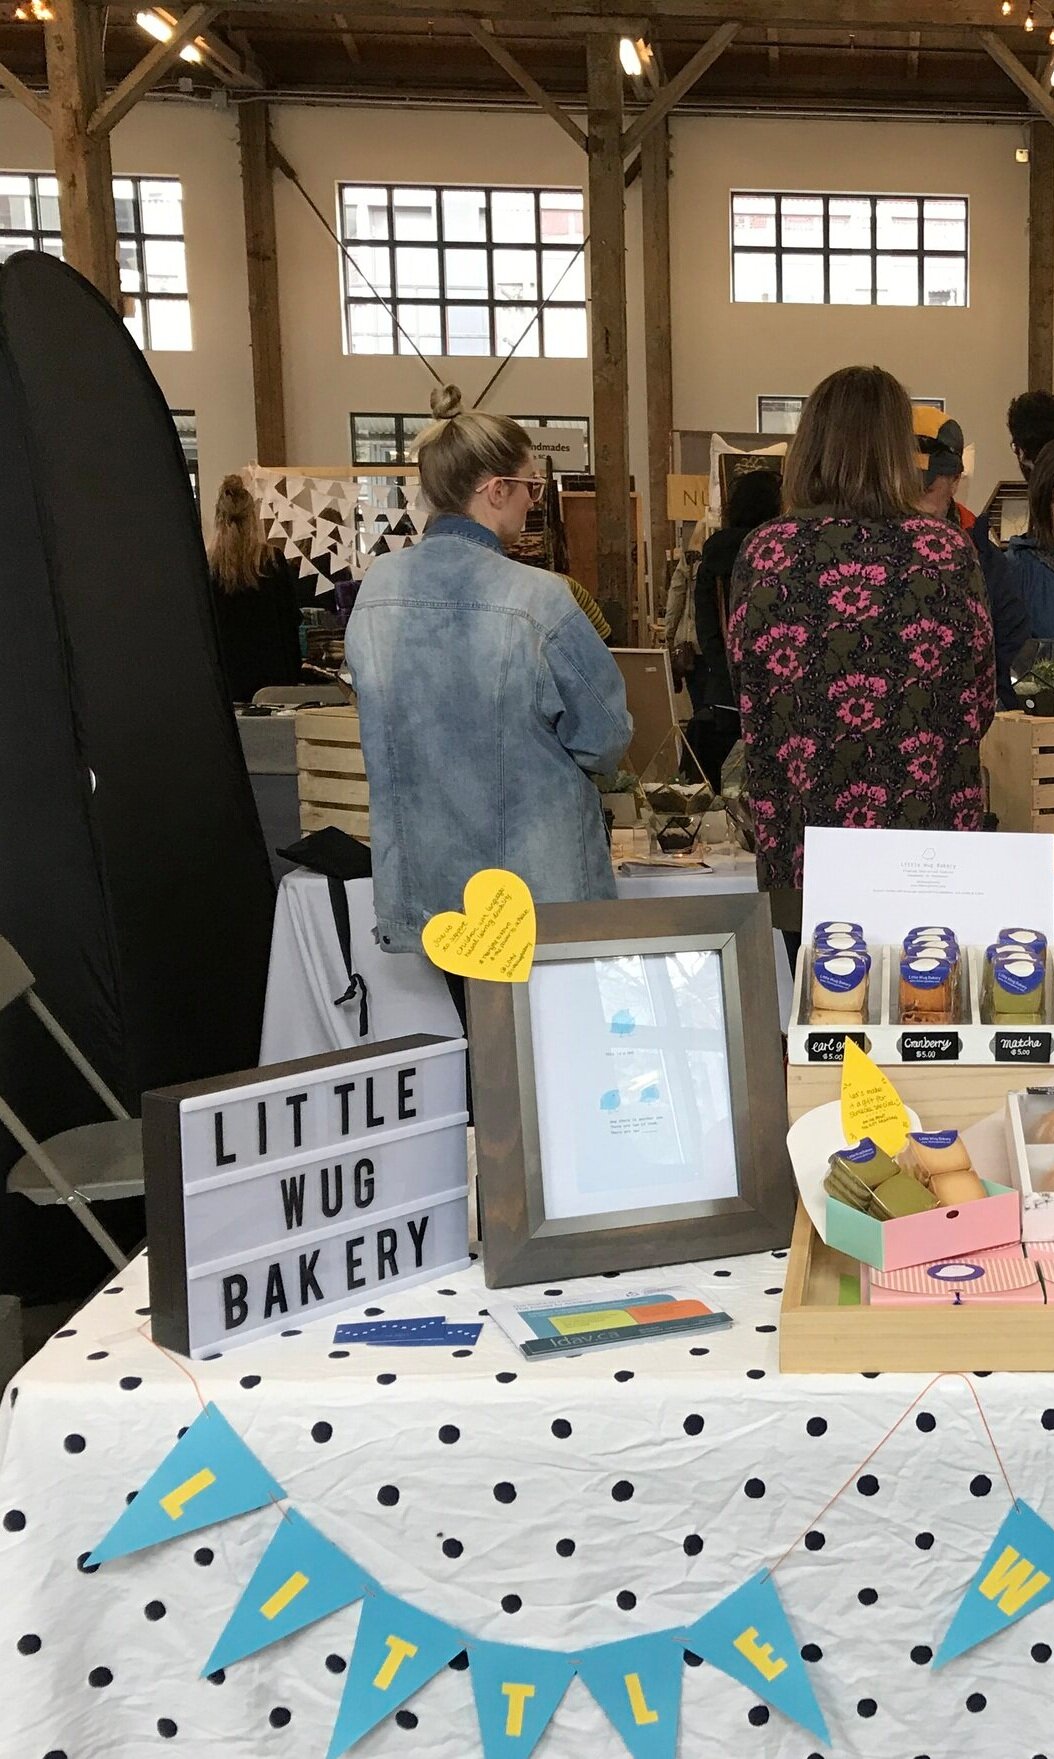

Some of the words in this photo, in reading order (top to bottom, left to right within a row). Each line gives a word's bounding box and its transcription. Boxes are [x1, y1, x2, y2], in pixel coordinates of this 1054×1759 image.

[531, 442, 570, 452] ndmades
[811, 1038, 835, 1053] earl
[904, 1038, 952, 1051] Cranberry
[916, 1051, 936, 1059] $5.00
[214, 1067, 416, 1167] LITTLE
[280, 1158, 375, 1230] WUG
[223, 1216, 429, 1331] BAKERY
